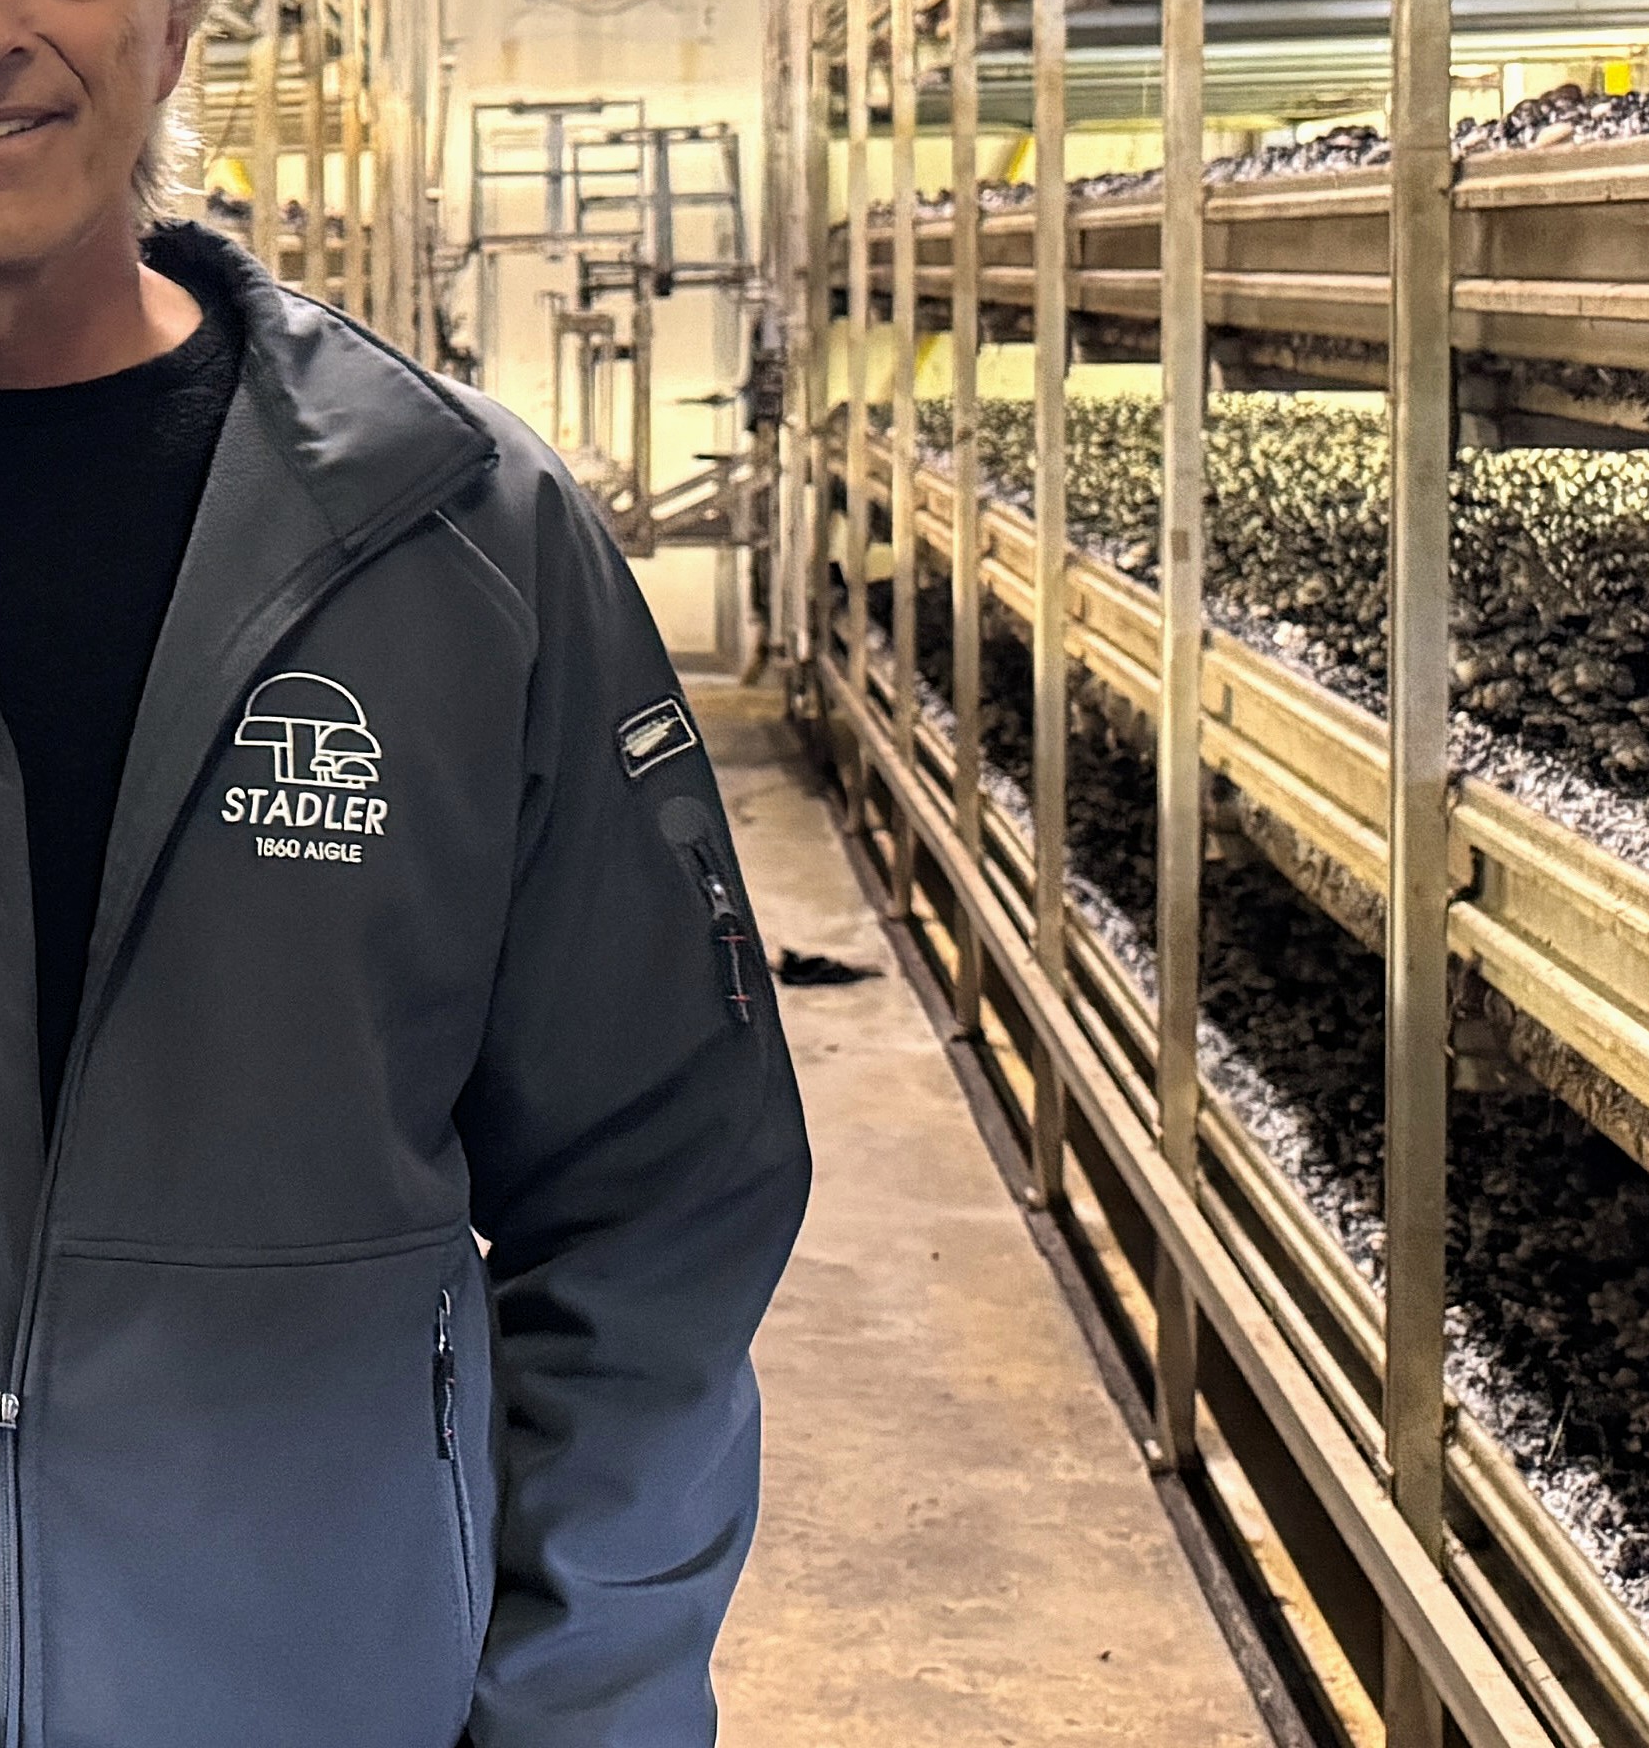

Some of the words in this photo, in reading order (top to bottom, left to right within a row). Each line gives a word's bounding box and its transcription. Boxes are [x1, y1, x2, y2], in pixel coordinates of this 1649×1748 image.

[221, 786, 388, 836] STADLER
[255, 836, 300, 859] 1860
[303, 840, 363, 863] AIGLE
